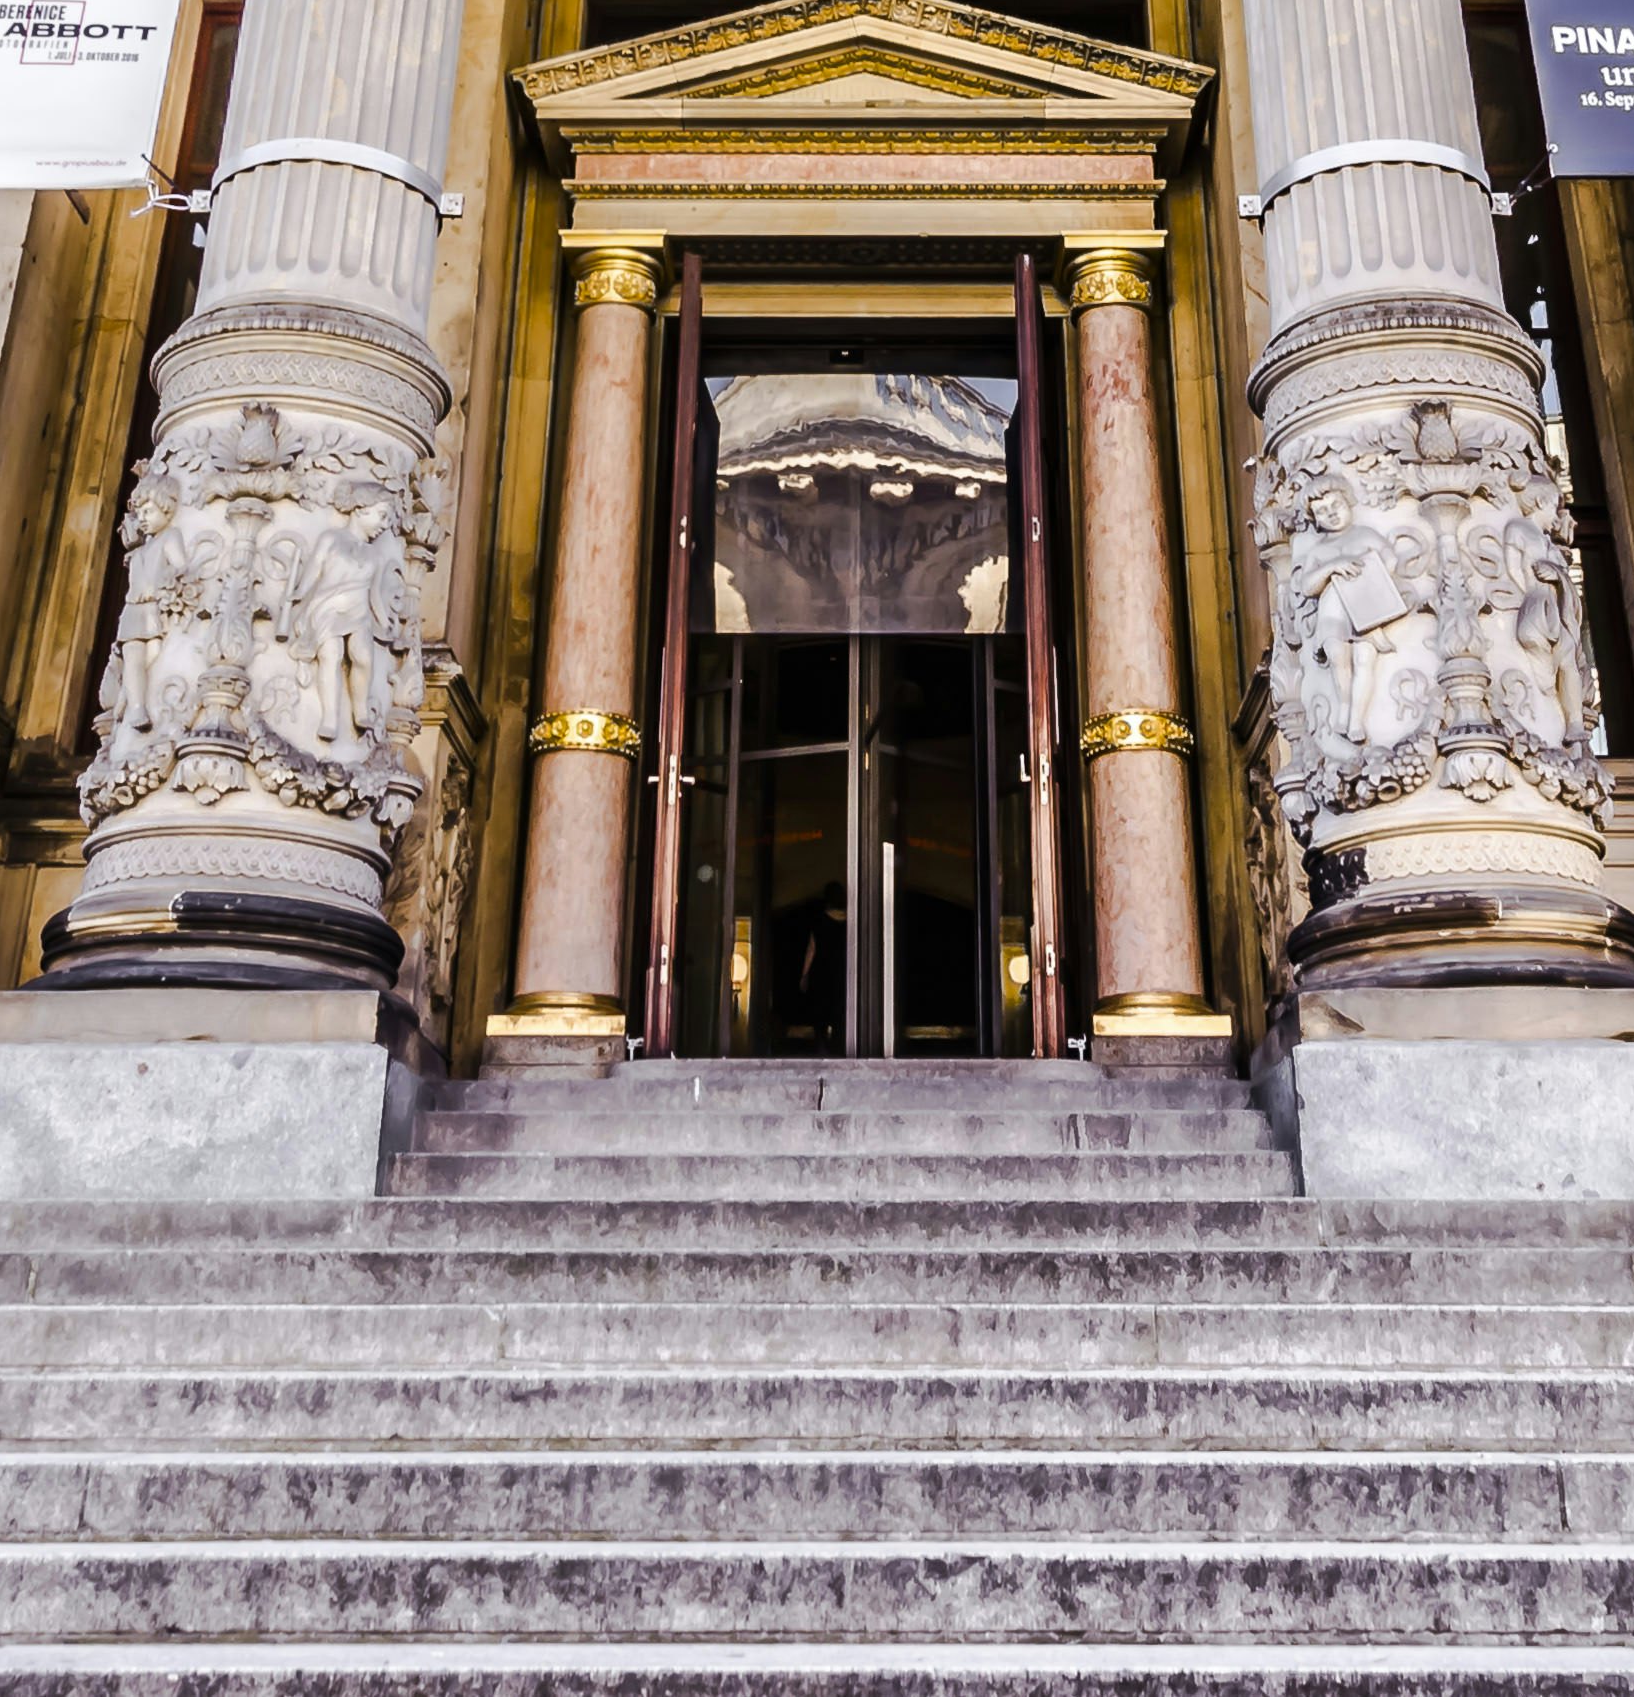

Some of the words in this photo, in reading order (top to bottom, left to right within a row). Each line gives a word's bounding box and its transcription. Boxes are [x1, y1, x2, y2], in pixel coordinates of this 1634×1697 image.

[3, 22, 157, 40] ABBOTT
[86, 52, 119, 61] OKTOBER
[1580, 92, 1603, 107] 16.
